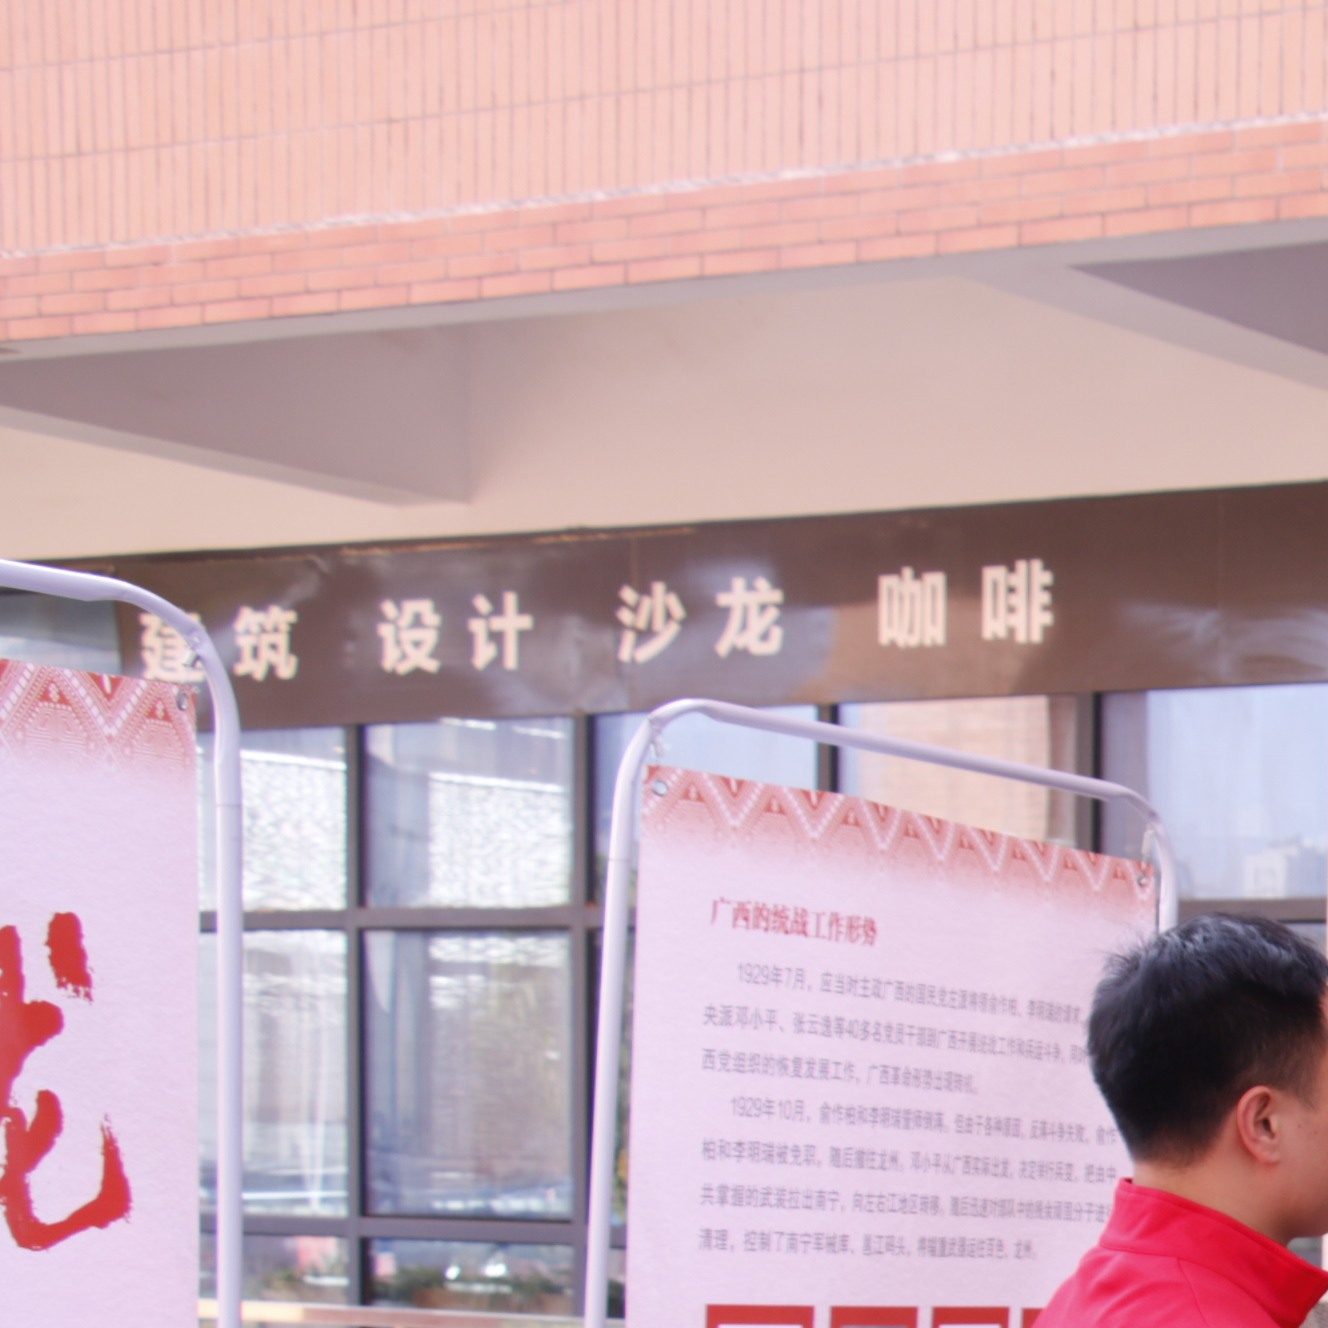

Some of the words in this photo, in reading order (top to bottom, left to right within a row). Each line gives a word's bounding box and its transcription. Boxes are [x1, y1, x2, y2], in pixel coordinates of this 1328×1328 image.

[138, 606, 299, 683] 建筑
[377, 591, 533, 676] 设计
[615, 576, 785, 664] 沙龙
[877, 558, 1055, 648] 咖啡
[709, 897, 878, 947] 广西的统战工作形势
